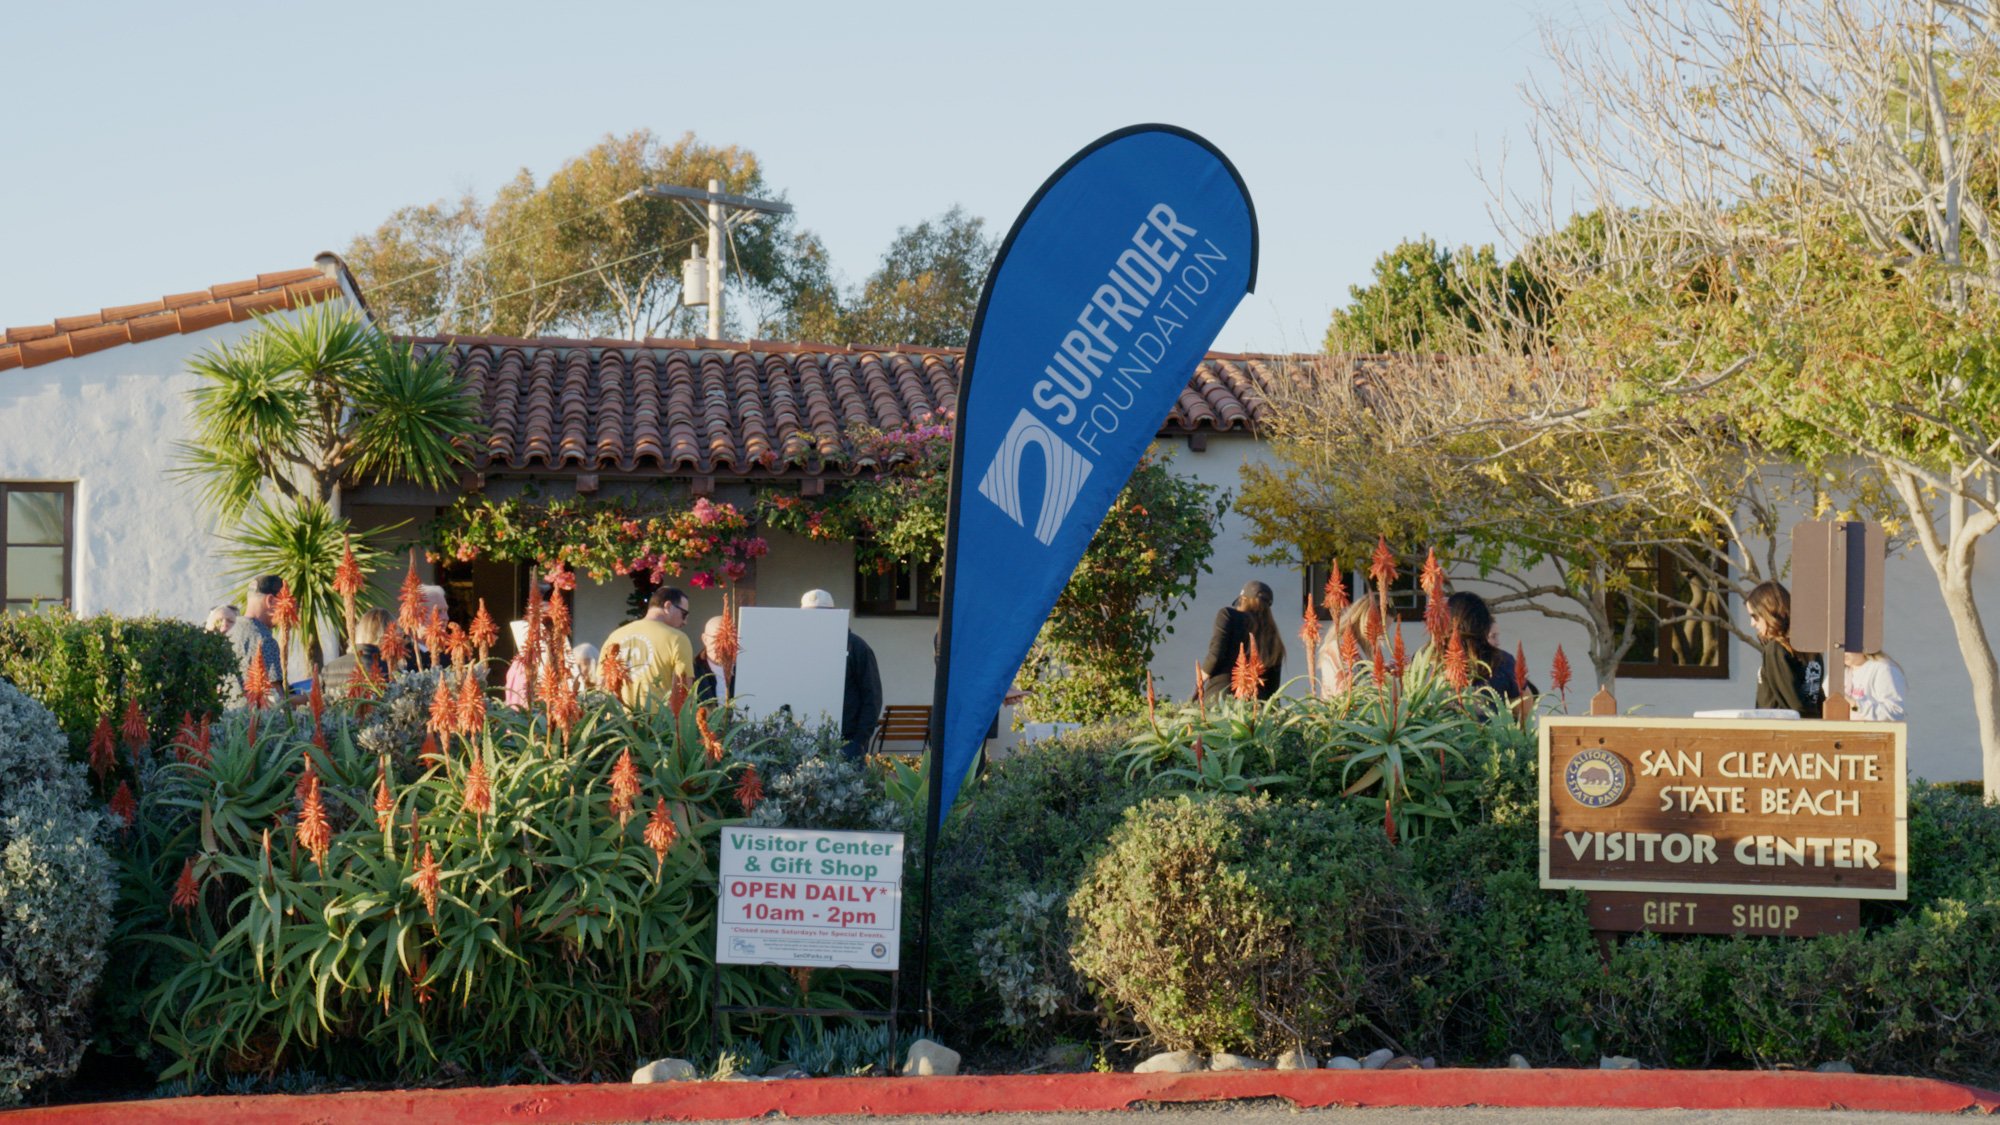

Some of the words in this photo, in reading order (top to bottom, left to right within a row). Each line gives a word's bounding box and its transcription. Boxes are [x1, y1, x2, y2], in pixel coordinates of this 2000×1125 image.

[1032, 202, 1198, 425] SURFRIDER
[1076, 238, 1228, 456] FOUNDATION
[1569, 752, 1621, 775] CALIFORNIA
[1640, 750, 1702, 777] SAN
[1717, 751, 1879, 781] CLEMENTE
[1568, 780, 1595, 804] STATE
[1598, 782, 1622, 804] PARKS
[1659, 785, 1746, 814] STATE
[1761, 788, 1860, 816] BEACH
[730, 833, 808, 853] Visitor
[815, 837, 894, 856] Center
[1564, 831, 1719, 864] VISITOR
[1734, 835, 1881, 869] CENTER
[744, 855, 761, 872] &
[770, 856, 813, 874] Gift
[820, 859, 878, 881] Shop
[731, 881, 796, 899] OPEN
[742, 903, 804, 921] 10am
[827, 906, 876, 928] 2pm
[1643, 901, 1698, 926] GIFT
[1732, 903, 1800, 929] SHOP
[781, 928, 817, 937] Saturdays
[830, 930, 858, 938] Special
